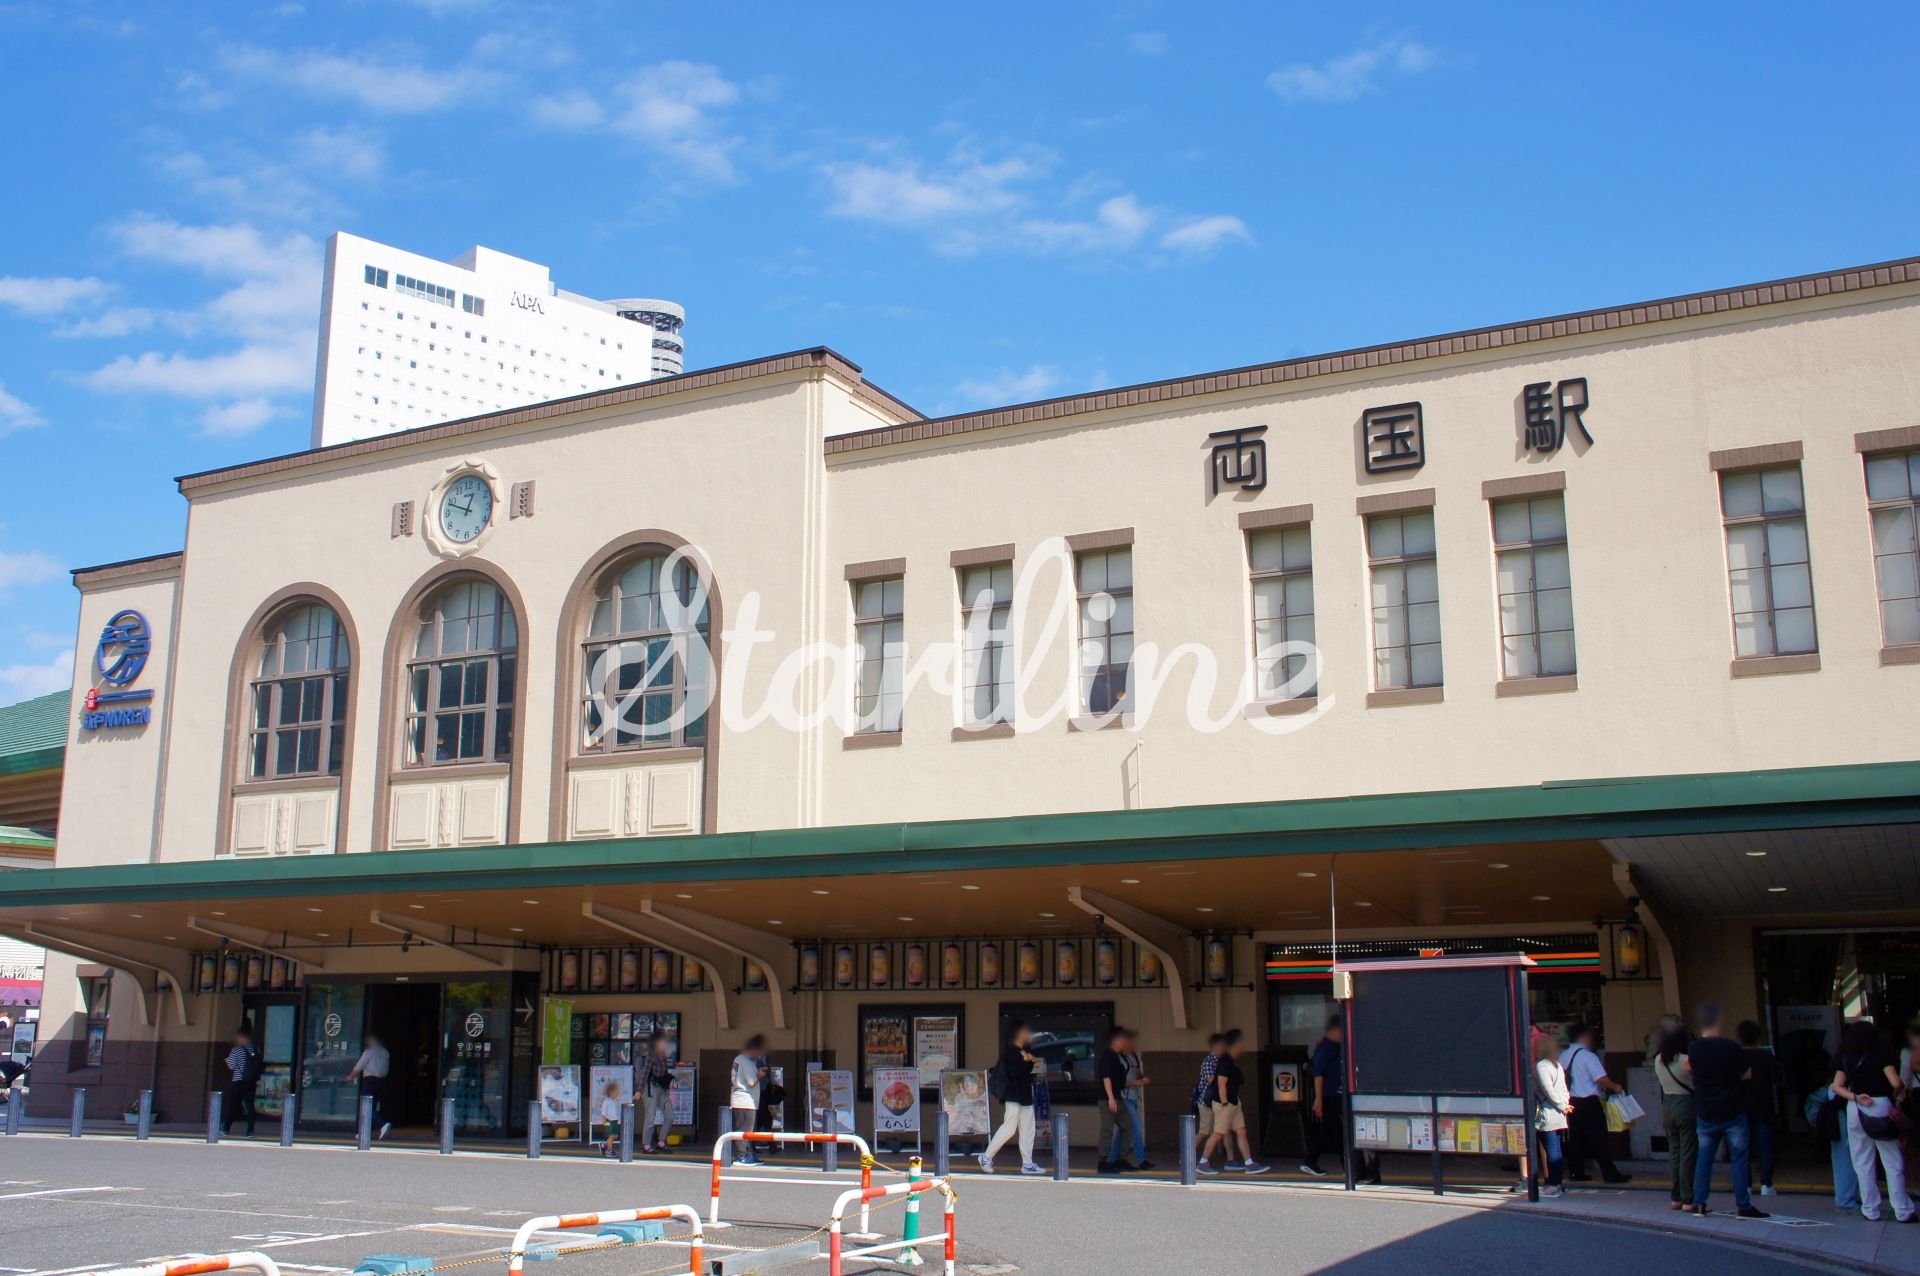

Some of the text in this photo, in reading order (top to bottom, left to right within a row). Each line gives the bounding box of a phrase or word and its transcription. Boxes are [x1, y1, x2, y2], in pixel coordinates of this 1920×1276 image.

[510, 291, 545, 315] APA
[1208, 376, 1595, 495] 両国駅
[465, 480, 473, 490] 12
[456, 486, 463, 496] 11
[483, 490, 489, 499] 2
[448, 497, 457, 506] 10
[444, 510, 450, 519] 9
[447, 521, 453, 530] 8
[455, 529, 461, 538] 7
[474, 526, 481, 535] 5
[463, 531, 470, 540] 6
